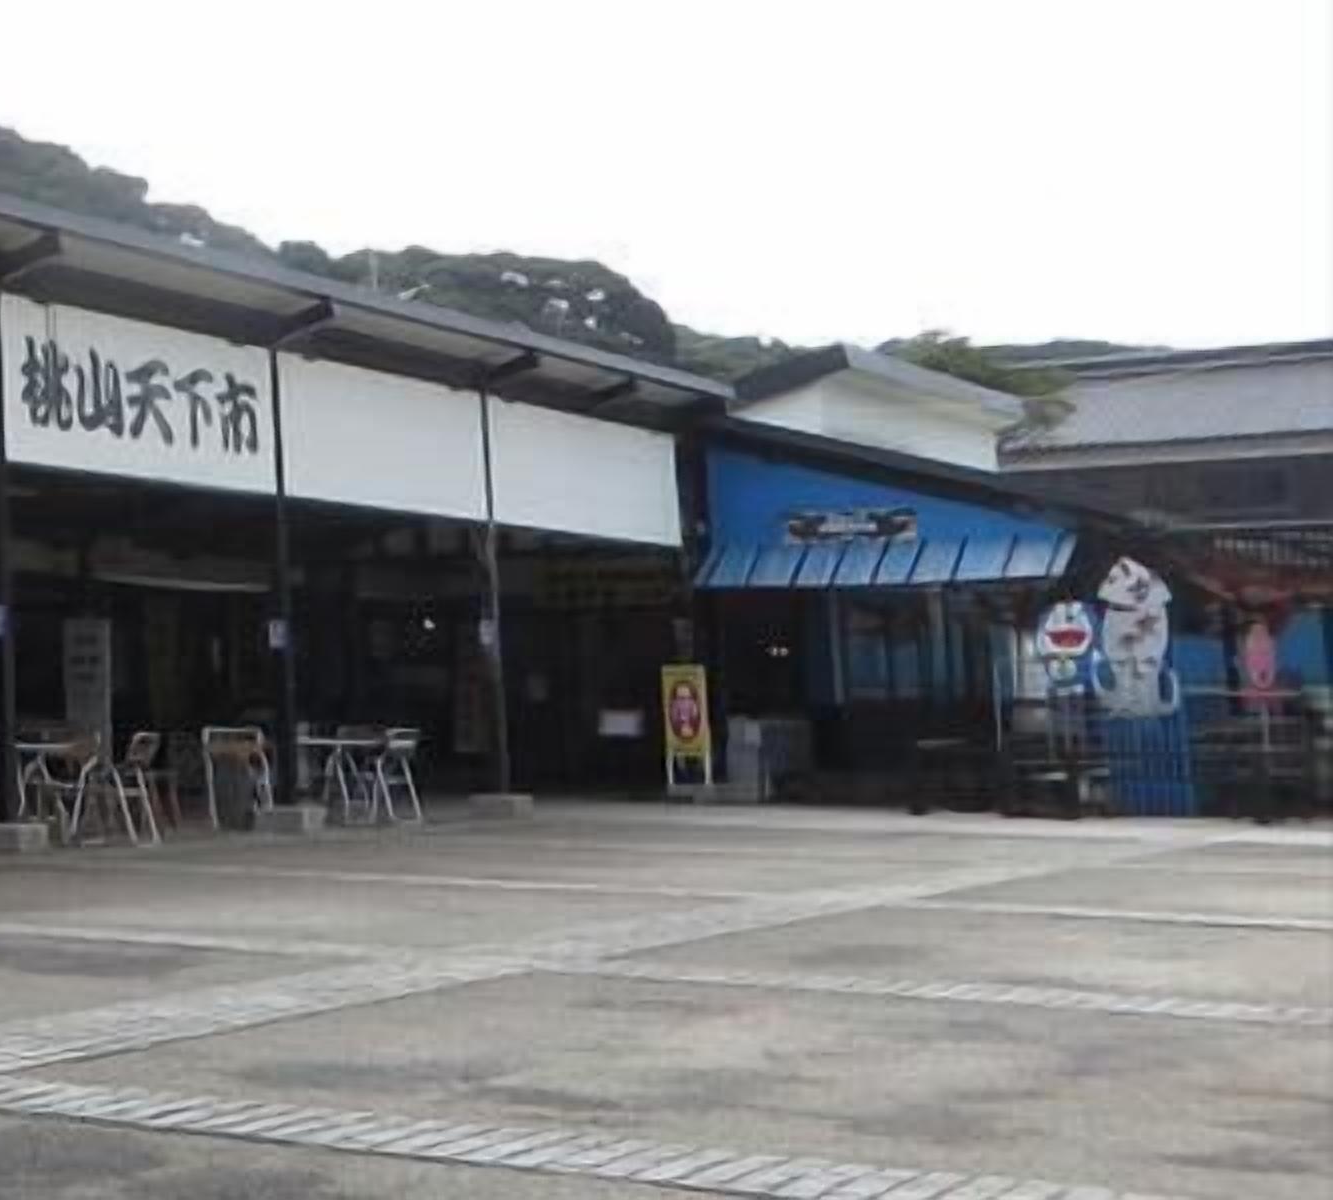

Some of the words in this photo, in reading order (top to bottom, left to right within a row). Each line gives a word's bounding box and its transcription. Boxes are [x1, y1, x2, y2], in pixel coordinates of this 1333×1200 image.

[21, 335, 258, 455] 桃山天下市
